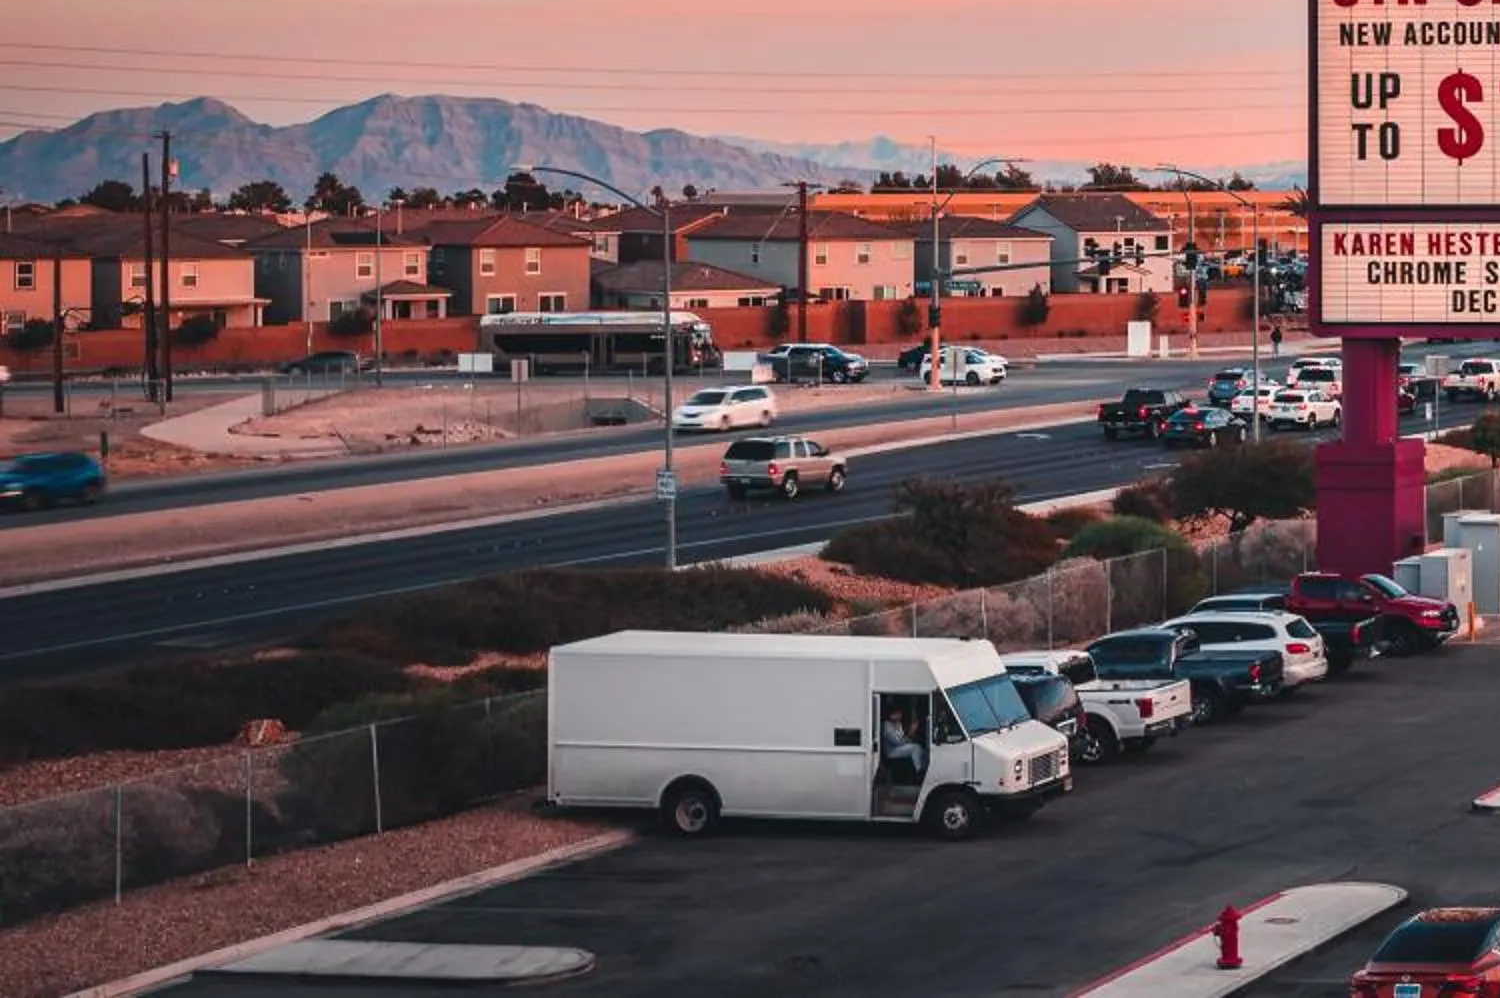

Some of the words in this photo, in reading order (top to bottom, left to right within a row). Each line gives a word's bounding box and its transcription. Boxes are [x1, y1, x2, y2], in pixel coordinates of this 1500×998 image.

[1339, 23, 1392, 46] NEW
[1351, 72, 1401, 110] UP
[1351, 121, 1400, 161] TO
[1333, 232, 1415, 256] KAREN
[1367, 261, 1467, 285] CHROME
[1452, 290, 1497, 314] DEC
